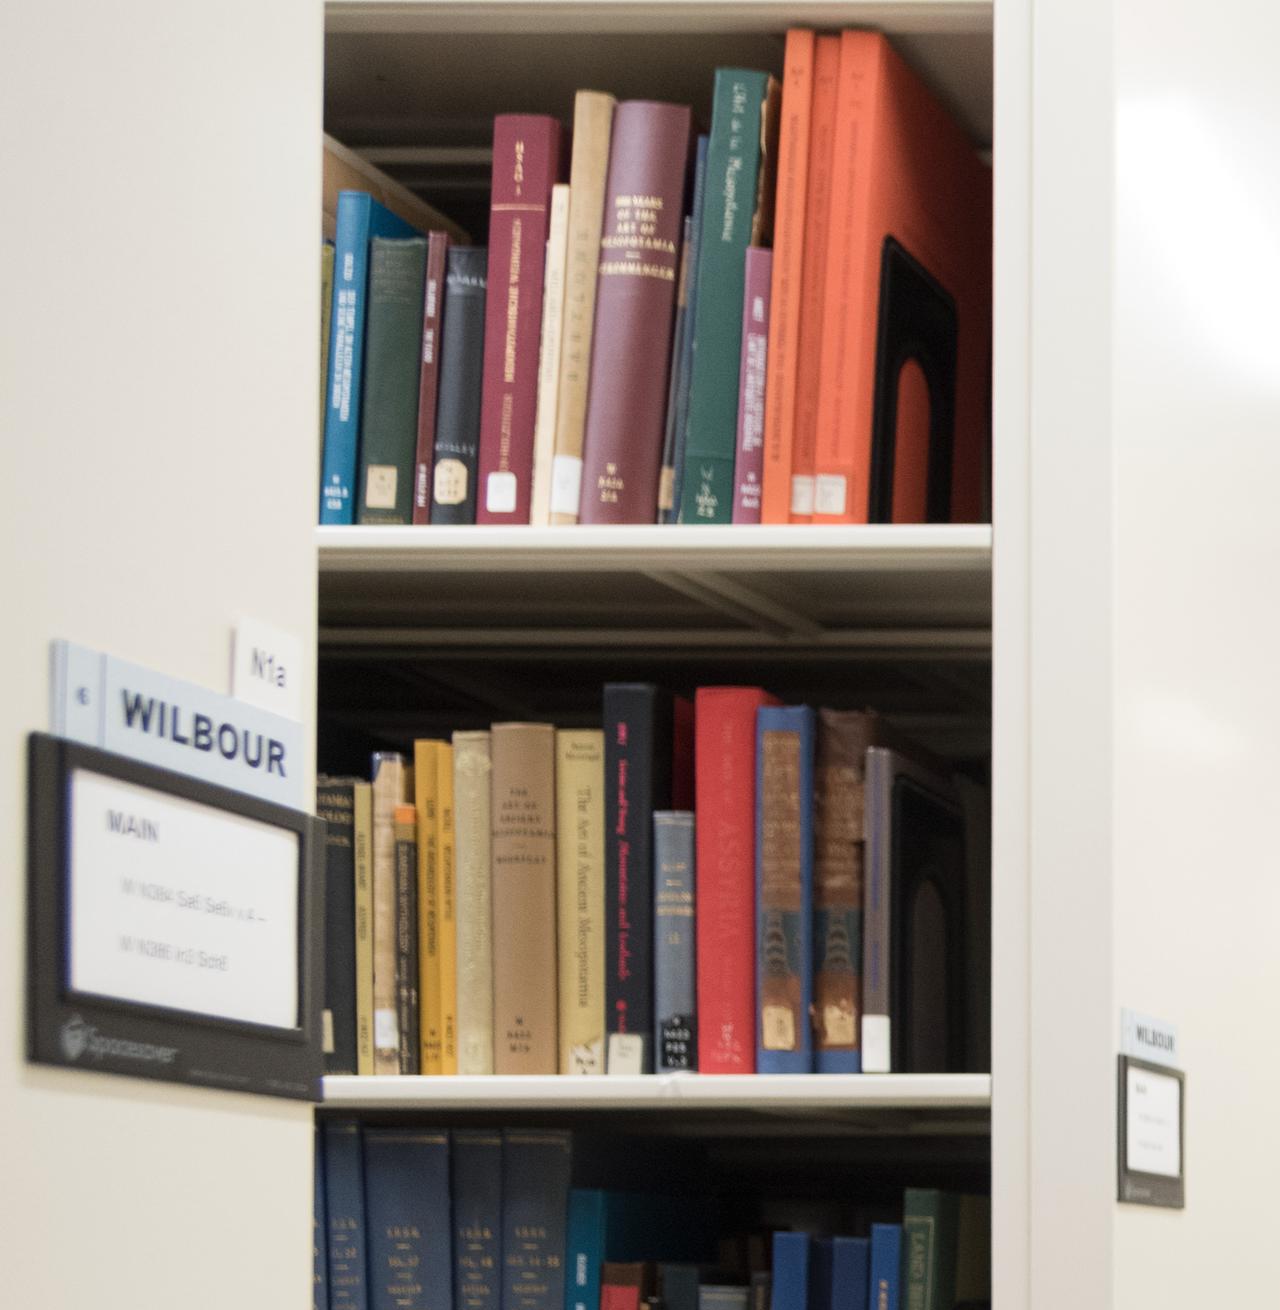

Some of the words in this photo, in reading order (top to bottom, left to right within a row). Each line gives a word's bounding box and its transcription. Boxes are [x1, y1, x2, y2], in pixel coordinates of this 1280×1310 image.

[250, 647, 288, 689] N1a
[121, 688, 288, 779] WILBOUR
[579, 786, 592, 813] The
[107, 809, 159, 843] MAIN
[575, 916, 591, 1009] Mesopotamia
[1136, 1024, 1176, 1054] WILBOUR
[911, 1232, 926, 1279] LAND
